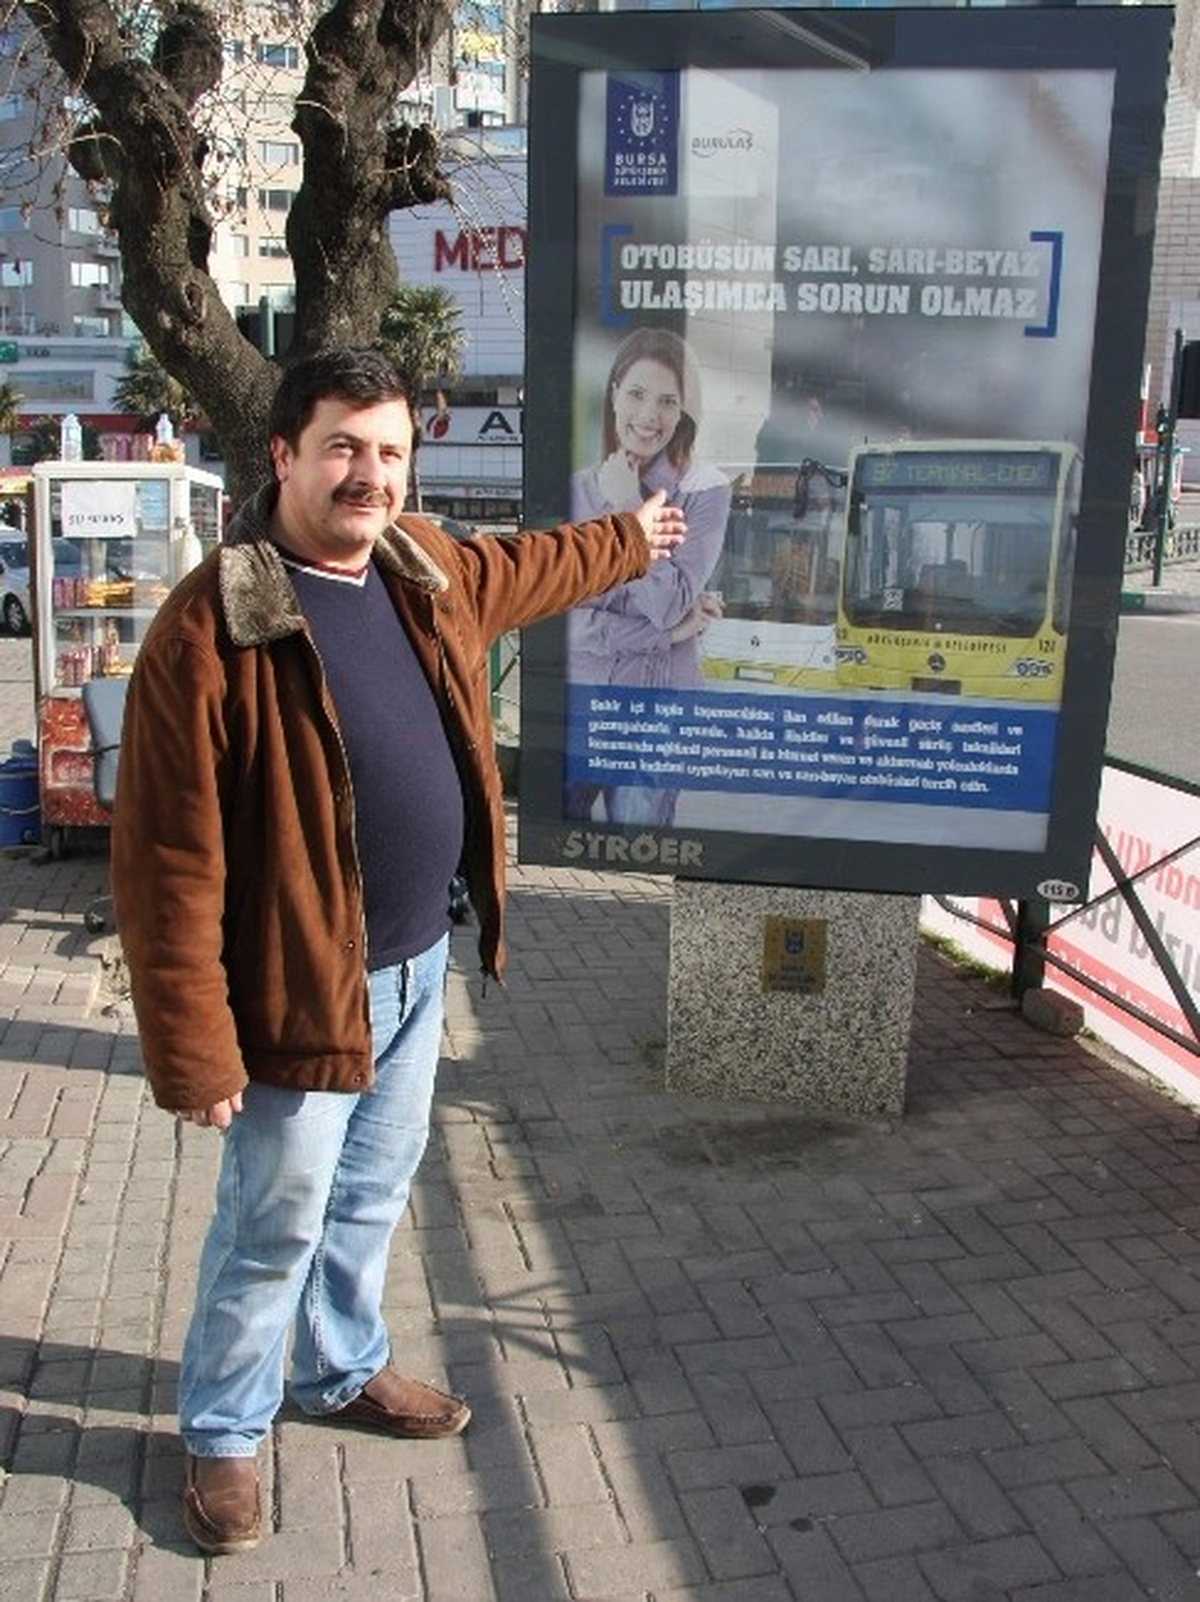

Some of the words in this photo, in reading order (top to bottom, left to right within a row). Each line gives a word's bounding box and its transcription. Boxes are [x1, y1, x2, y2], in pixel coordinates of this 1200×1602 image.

[615, 153, 668, 166] BURSA
[620, 239, 776, 272] OTOBÜSÜM
[783, 245, 858, 276] SARI,
[868, 248, 1040, 277] SARI-BEYAZ
[620, 280, 787, 316] ULAŞIMDA
[797, 283, 910, 314] SORUN
[920, 286, 1038, 318] OLMAZ
[562, 829, 704, 867] STRÖER
